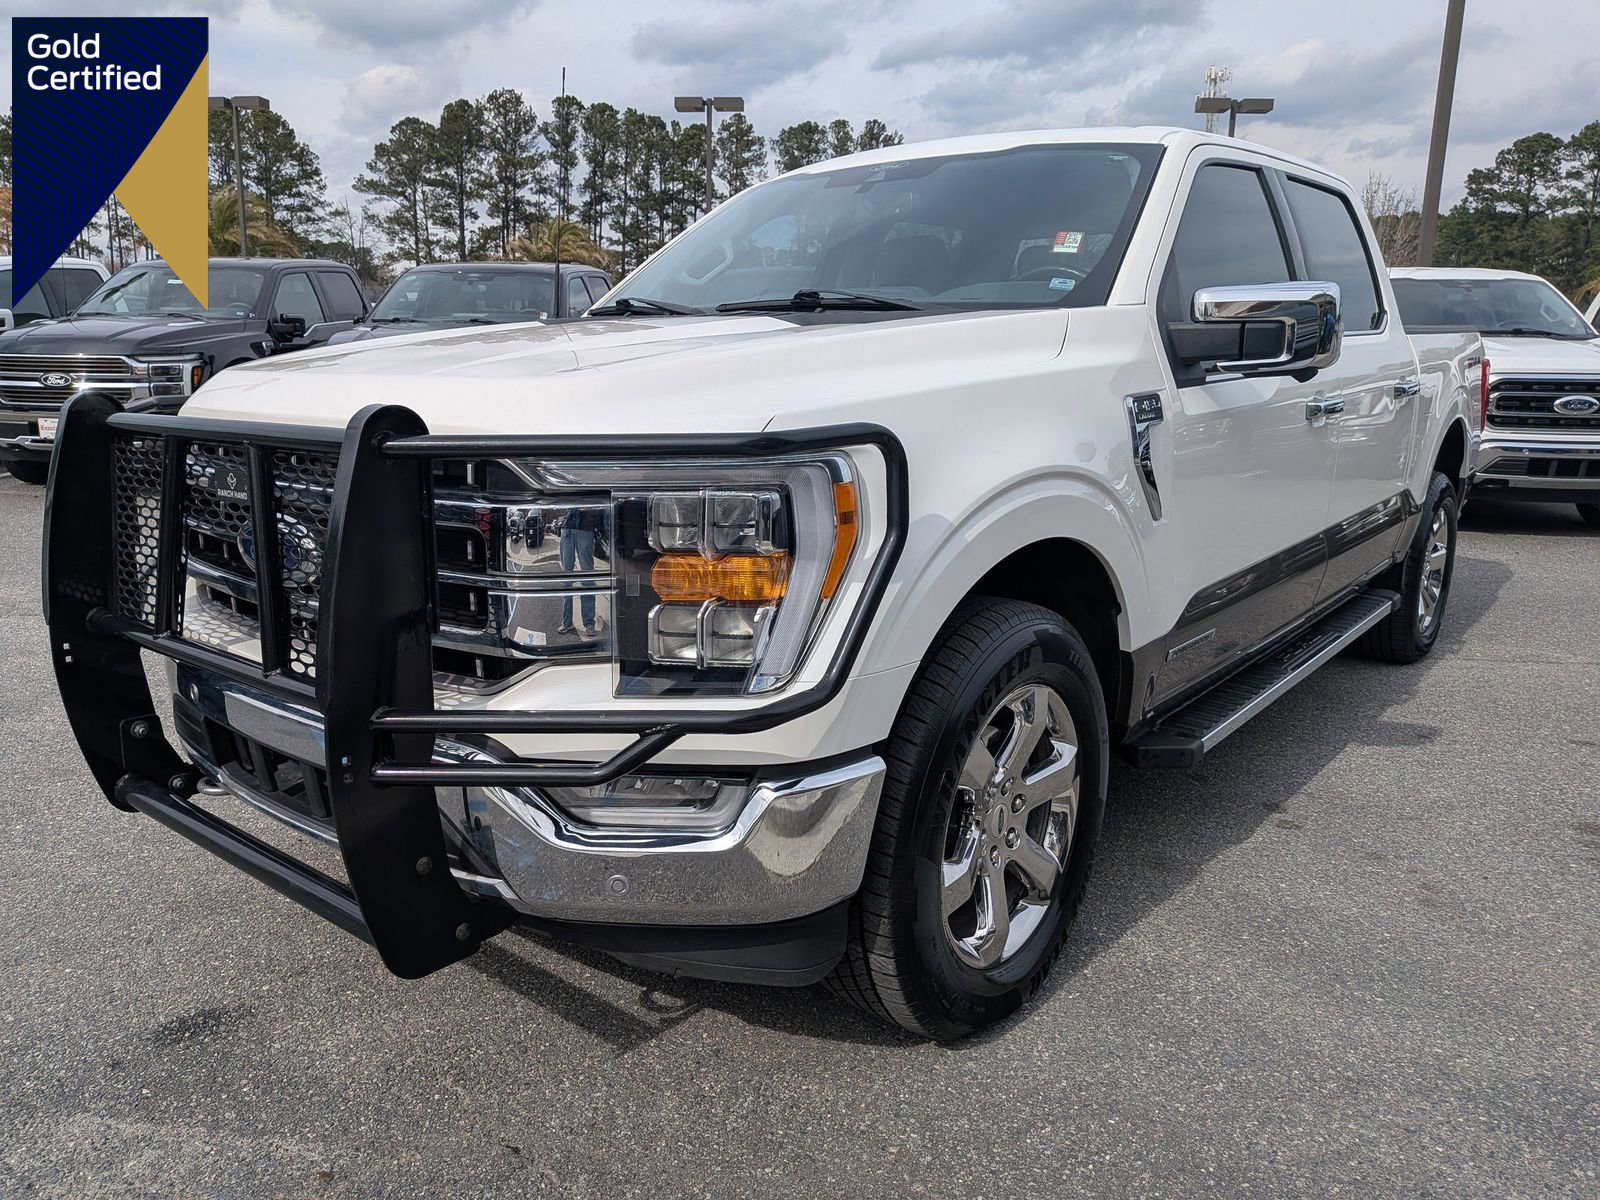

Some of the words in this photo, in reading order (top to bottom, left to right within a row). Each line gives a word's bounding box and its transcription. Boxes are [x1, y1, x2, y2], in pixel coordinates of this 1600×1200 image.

[46, 375, 66, 385] Ford
[1567, 400, 1590, 409] Ford
[217, 488, 233, 498] RANCH
[234, 490, 248, 500] HAND
